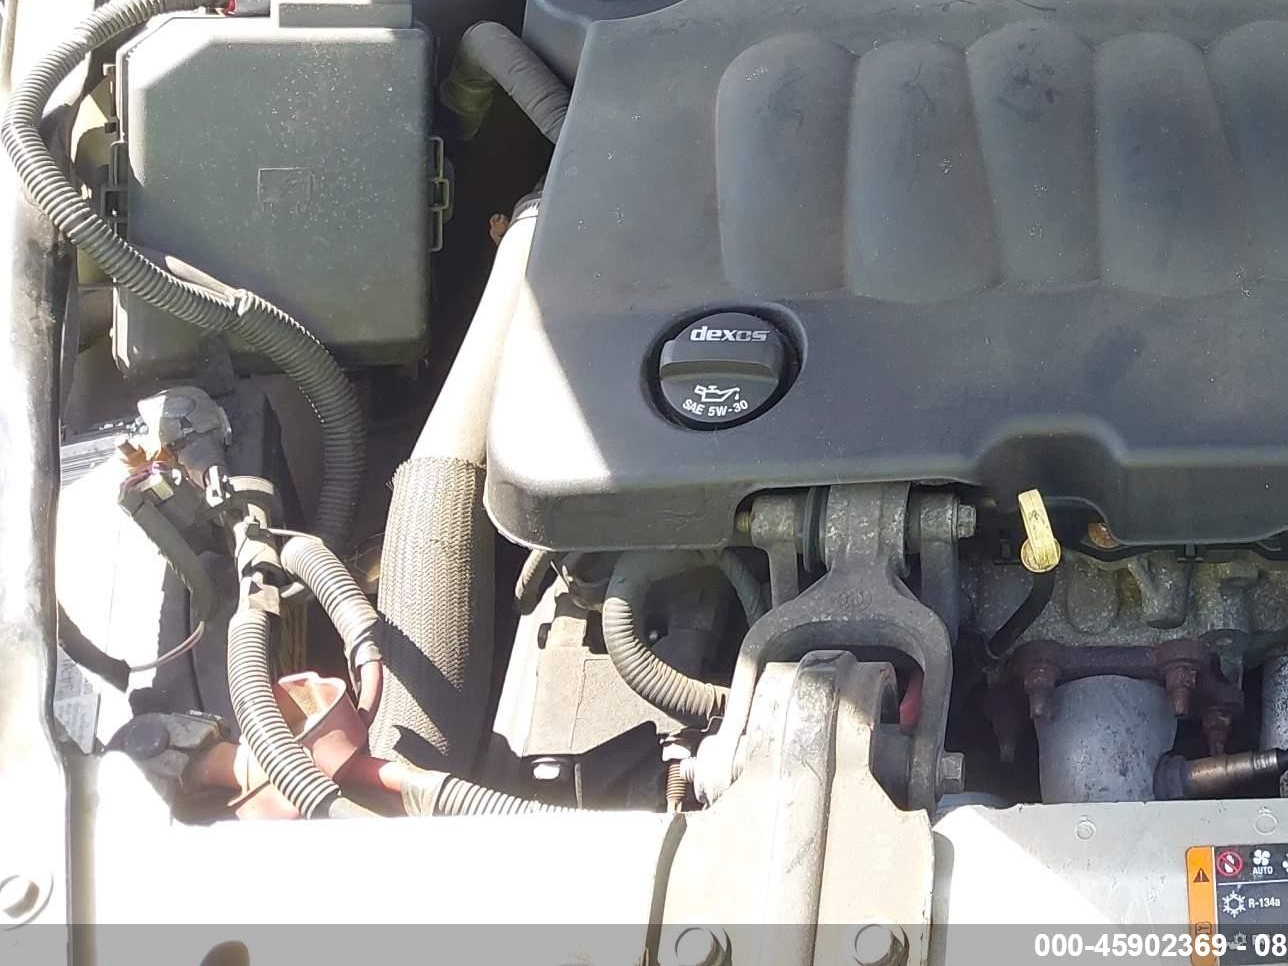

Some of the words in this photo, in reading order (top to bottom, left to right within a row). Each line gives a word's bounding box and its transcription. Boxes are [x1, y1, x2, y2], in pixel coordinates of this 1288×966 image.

[690, 325, 770, 342] dexos
[682, 399, 705, 416] SAE
[707, 400, 749, 417] 5W-30
[1252, 866, 1274, 875] AUTO
[1248, 897, 1281, 908] R-134a
